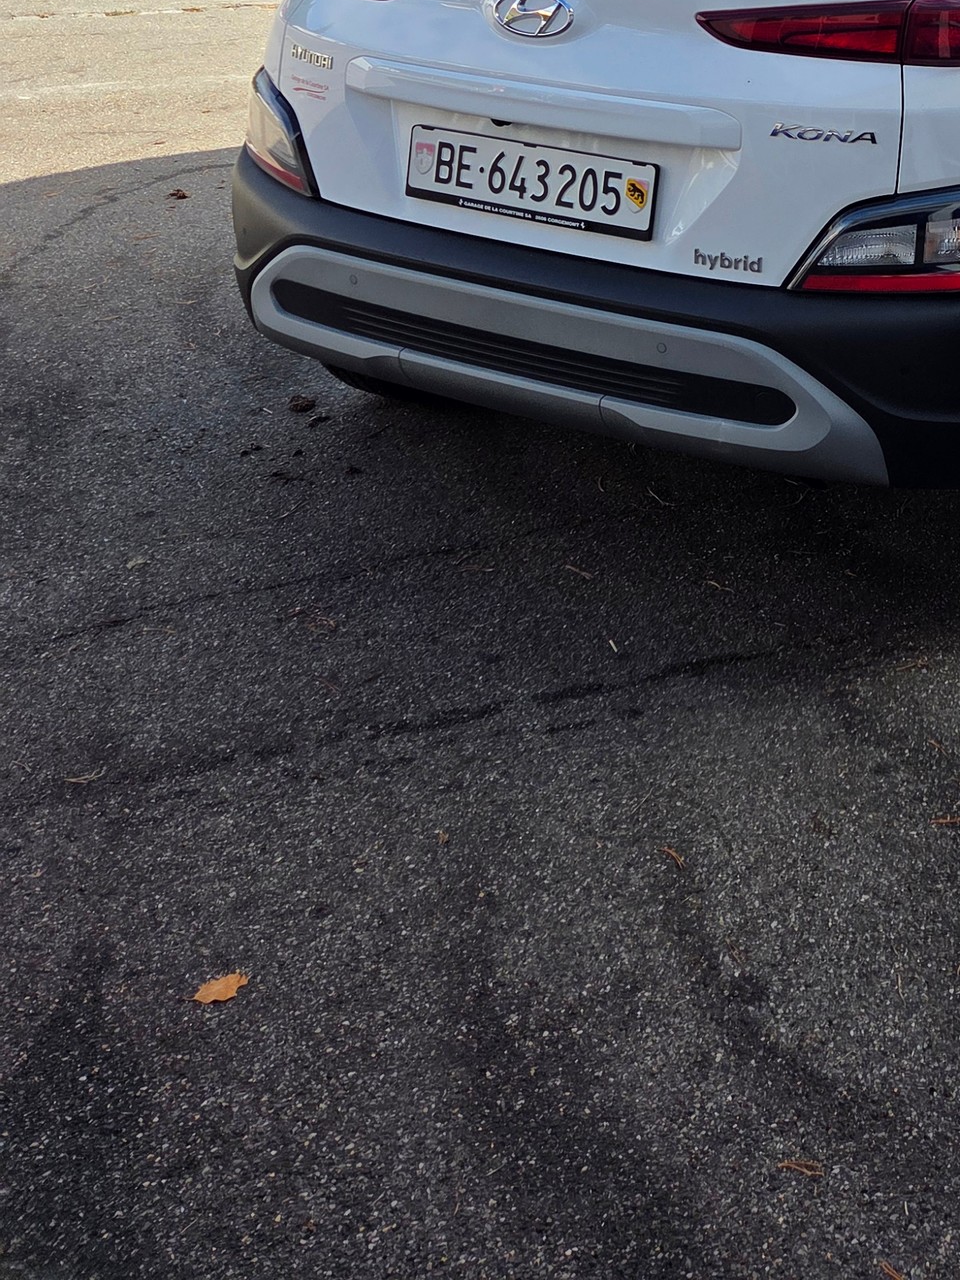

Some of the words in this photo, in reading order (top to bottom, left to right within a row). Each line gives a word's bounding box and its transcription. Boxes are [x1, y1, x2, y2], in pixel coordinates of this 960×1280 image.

[291, 44, 333, 70] HYUNDAI
[769, 121, 878, 144] KONA
[693, 248, 763, 273] hybrid
